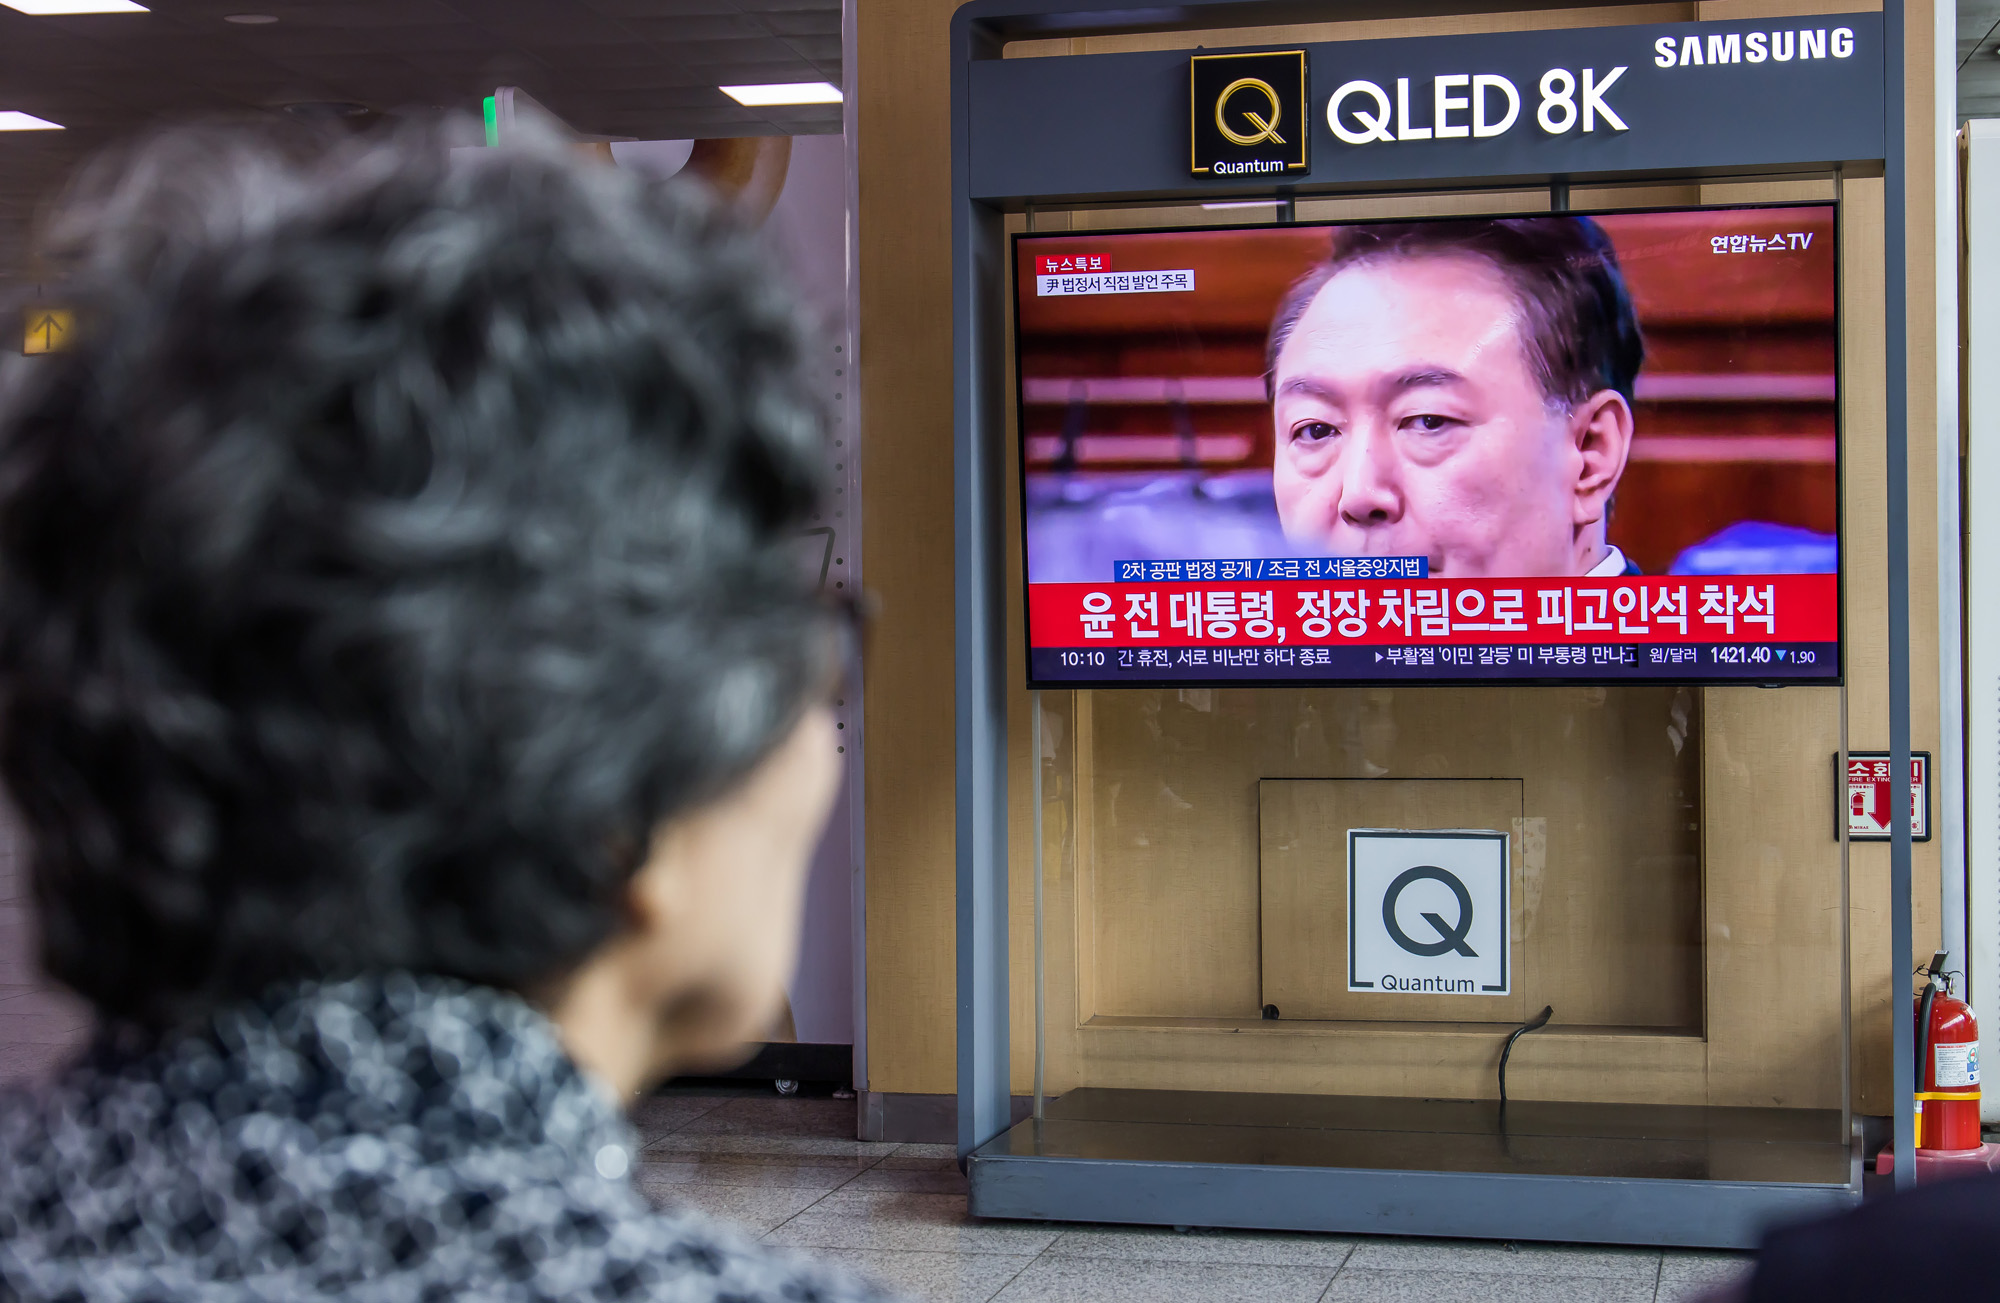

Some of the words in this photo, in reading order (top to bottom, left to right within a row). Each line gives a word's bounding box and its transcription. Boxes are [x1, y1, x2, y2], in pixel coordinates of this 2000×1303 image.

[1654, 27, 1854, 68] SAMSUNG
[1215, 77, 1287, 147] Q
[1326, 74, 1521, 145] QLED
[1537, 66, 1629, 135] 8K
[1213, 159, 1285, 176] Quantum
[1710, 232, 1814, 254] 연합뉴스TV
[1045, 256, 1103, 273] 뉴스특보
[1046, 278, 1060, 294] 尹
[1062, 276, 1101, 293] 법정서
[1103, 274, 1130, 291] 직접
[1132, 273, 1158, 290] 발언
[1160, 272, 1188, 289] 주목
[1122, 561, 1147, 580] 2차
[1149, 561, 1182, 580] 공판
[1185, 560, 1216, 580] 법정
[1220, 560, 1252, 580] 공개
[1268, 560, 1301, 578] 조금
[1304, 559, 1321, 578] 전
[1324, 558, 1420, 578] 서울중앙지법
[1079, 591, 1116, 639] 윤
[1123, 591, 1160, 639] 전
[1169, 590, 1286, 644] 대통령,
[1295, 589, 1371, 638] 정장
[1377, 588, 1528, 637] 차림으로
[1536, 585, 1688, 636] 피고인석
[1697, 584, 1775, 635] 착석
[1060, 651, 1105, 667] 10:10
[1118, 649, 1134, 667] 간
[1137, 649, 1173, 669] 휴전,
[1176, 649, 1209, 667] 서로
[1212, 648, 1260, 667] 비난만
[1263, 648, 1296, 667] 하다
[1298, 648, 1332, 666] 종료
[1386, 647, 1435, 666] 부활절
[1517, 646, 1533, 665] 미
[1537, 646, 1586, 665] 부통령
[1649, 647, 1697, 664] 원/달러
[1710, 646, 1771, 664] 1421.40
[1789, 651, 1816, 664] 1.90
[1382, 865, 1480, 958] Q
[1381, 974, 1474, 993] Quantum
